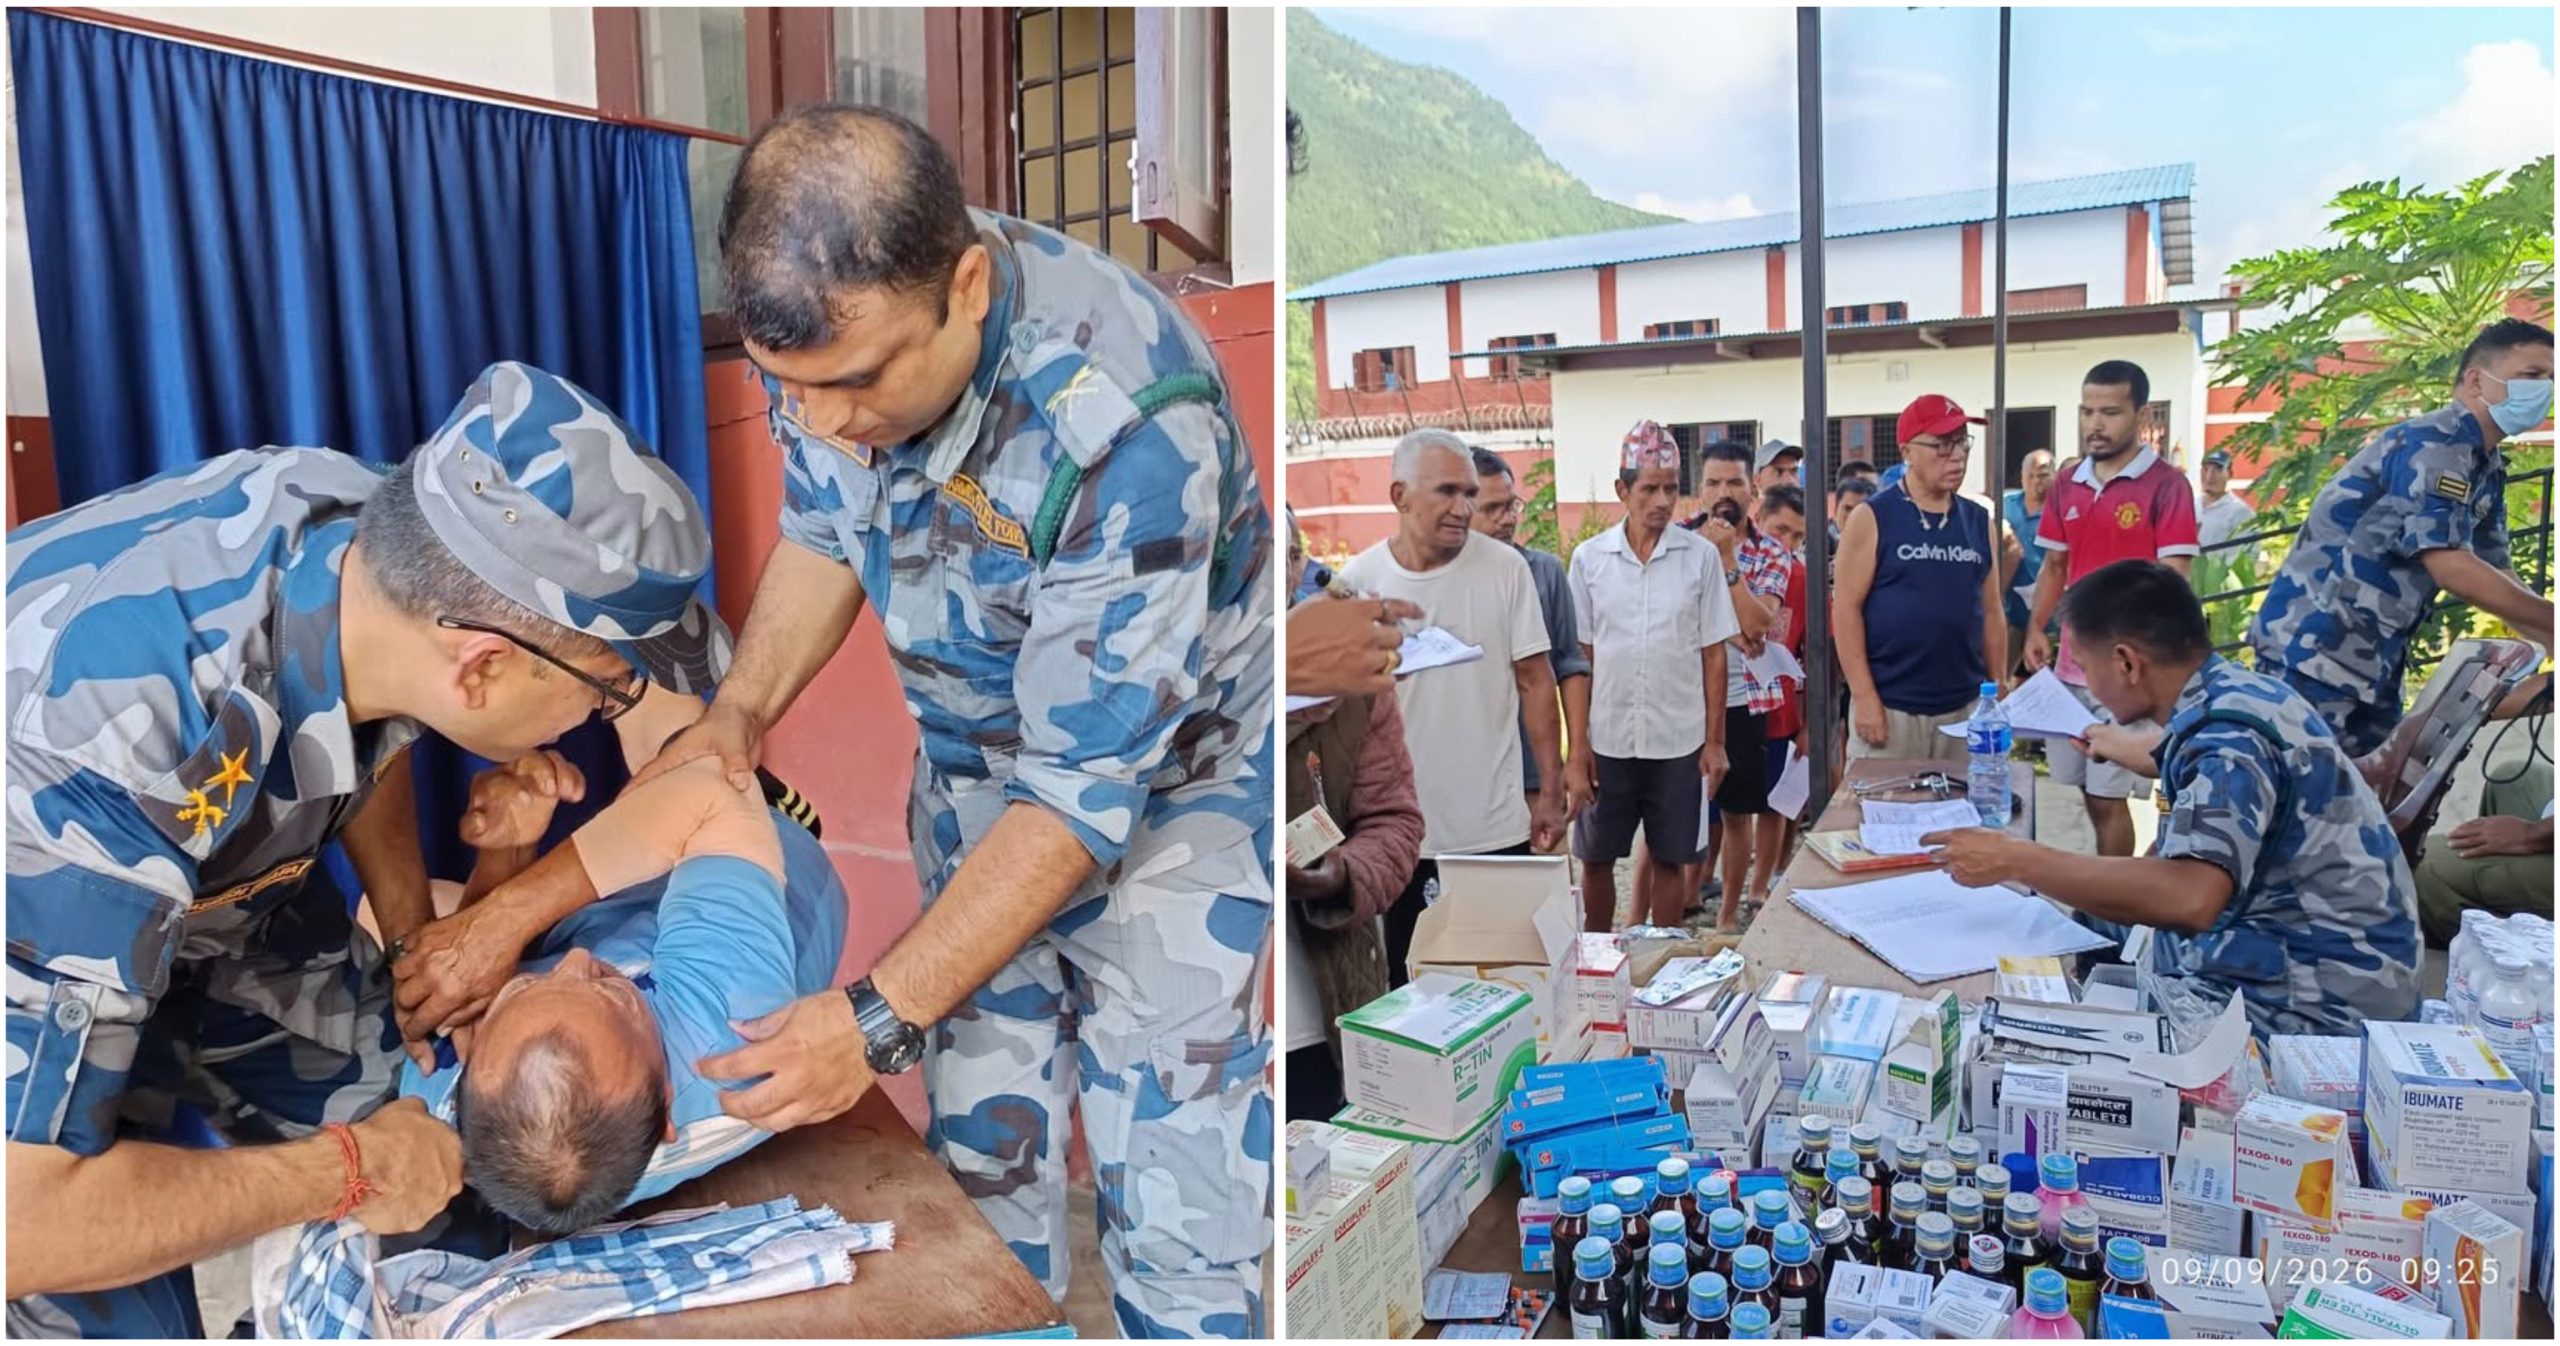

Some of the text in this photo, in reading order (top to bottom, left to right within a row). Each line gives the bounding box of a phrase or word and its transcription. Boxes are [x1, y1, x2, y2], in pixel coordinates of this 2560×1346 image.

[1897, 542, 1982, 564] Calvin Klein
[1453, 1044, 1493, 1082] R-TIN
[2404, 1091, 2464, 1111] IBUMATE
[2067, 1107, 2128, 1125] TABLETS
[2238, 1146, 2293, 1167] FEXOD-180
[2106, 1190, 2160, 1203] CLOBACT
[2283, 1230, 2331, 1243] FEXOD-180
[2345, 1248, 2400, 1263] FEXOD-180
